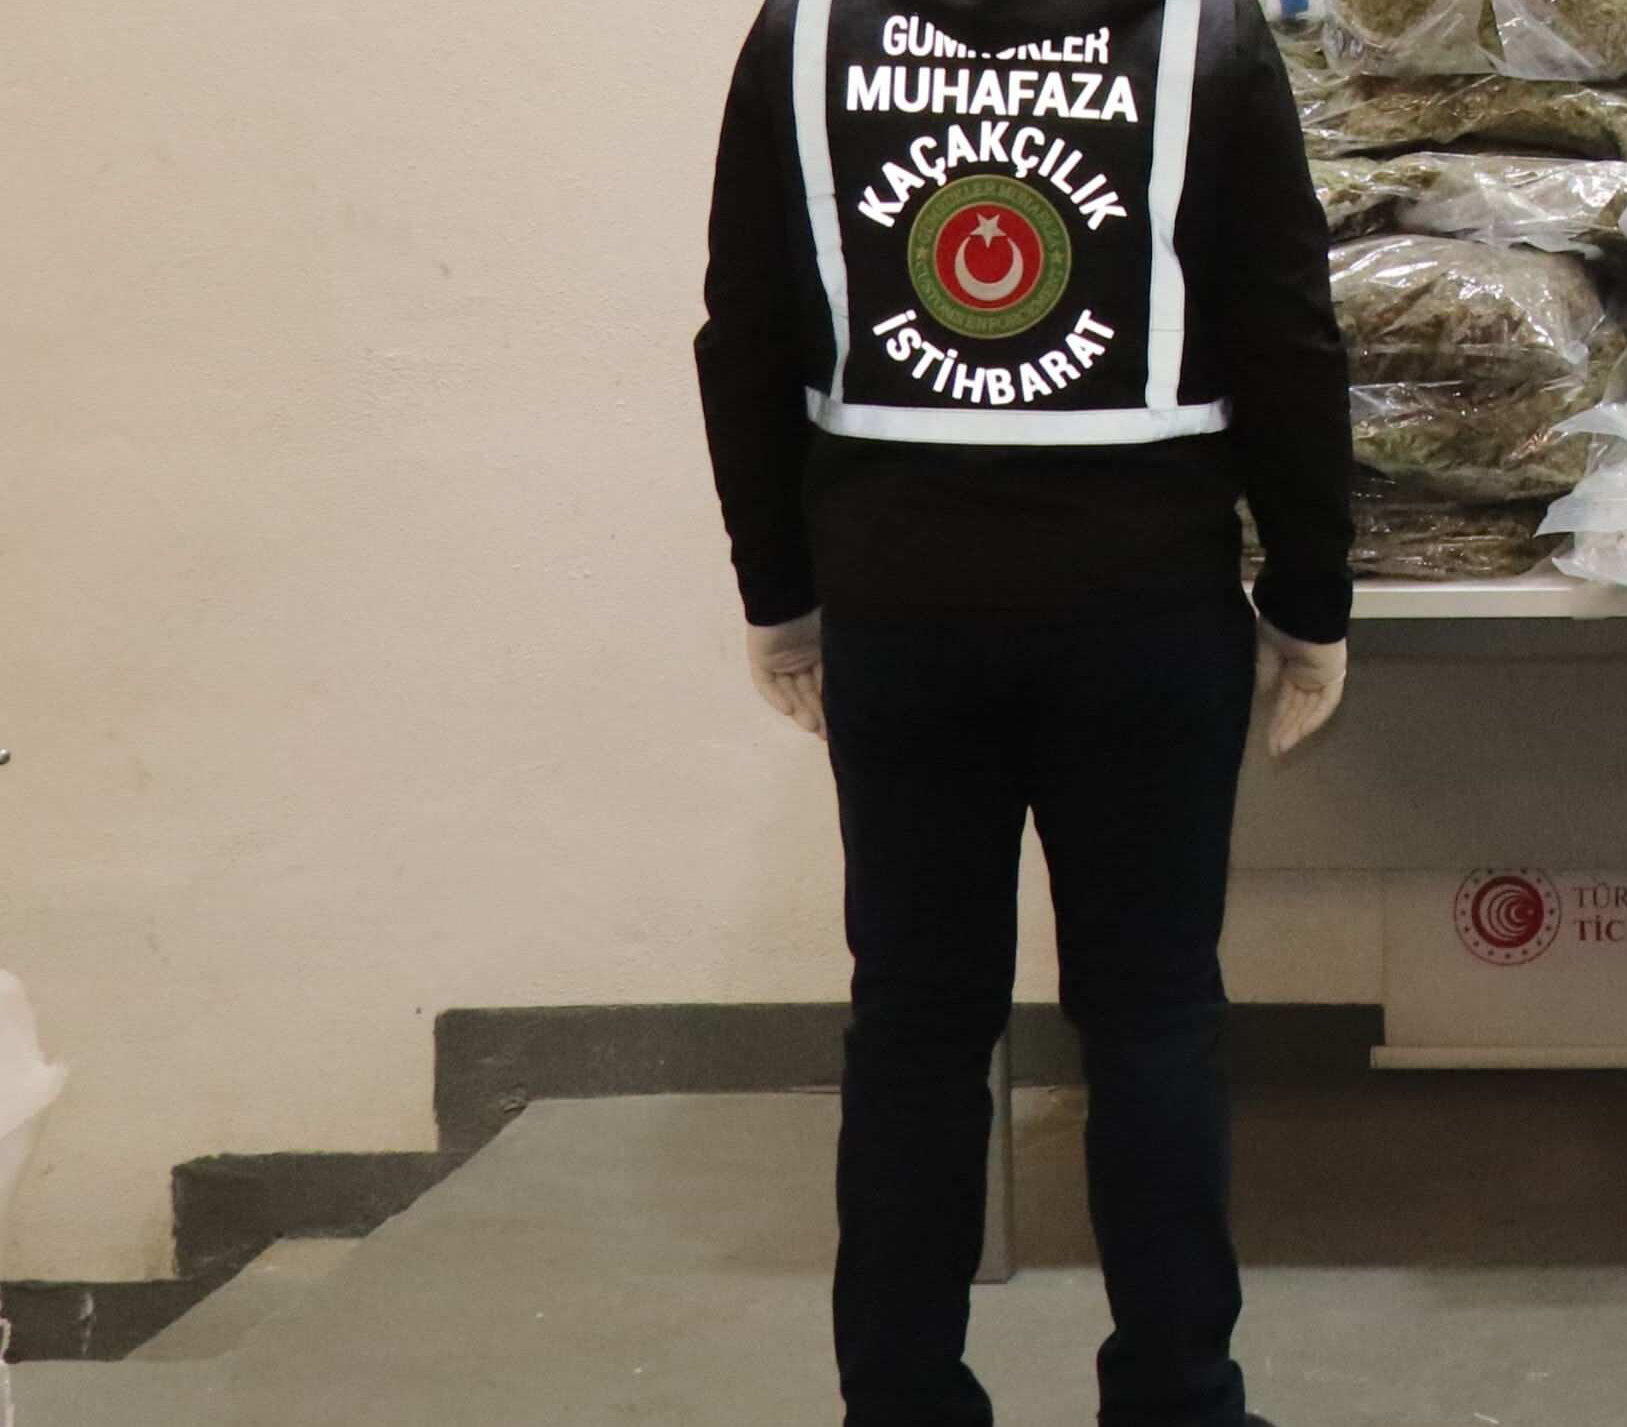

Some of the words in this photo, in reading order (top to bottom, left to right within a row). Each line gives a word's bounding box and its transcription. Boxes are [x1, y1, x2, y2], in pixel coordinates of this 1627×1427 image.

[846, 65, 1139, 123] MUHAFAZA
[857, 121, 1128, 231] KAÇAKÇILIK
[872, 308, 1116, 406] İSTİHBARAT
